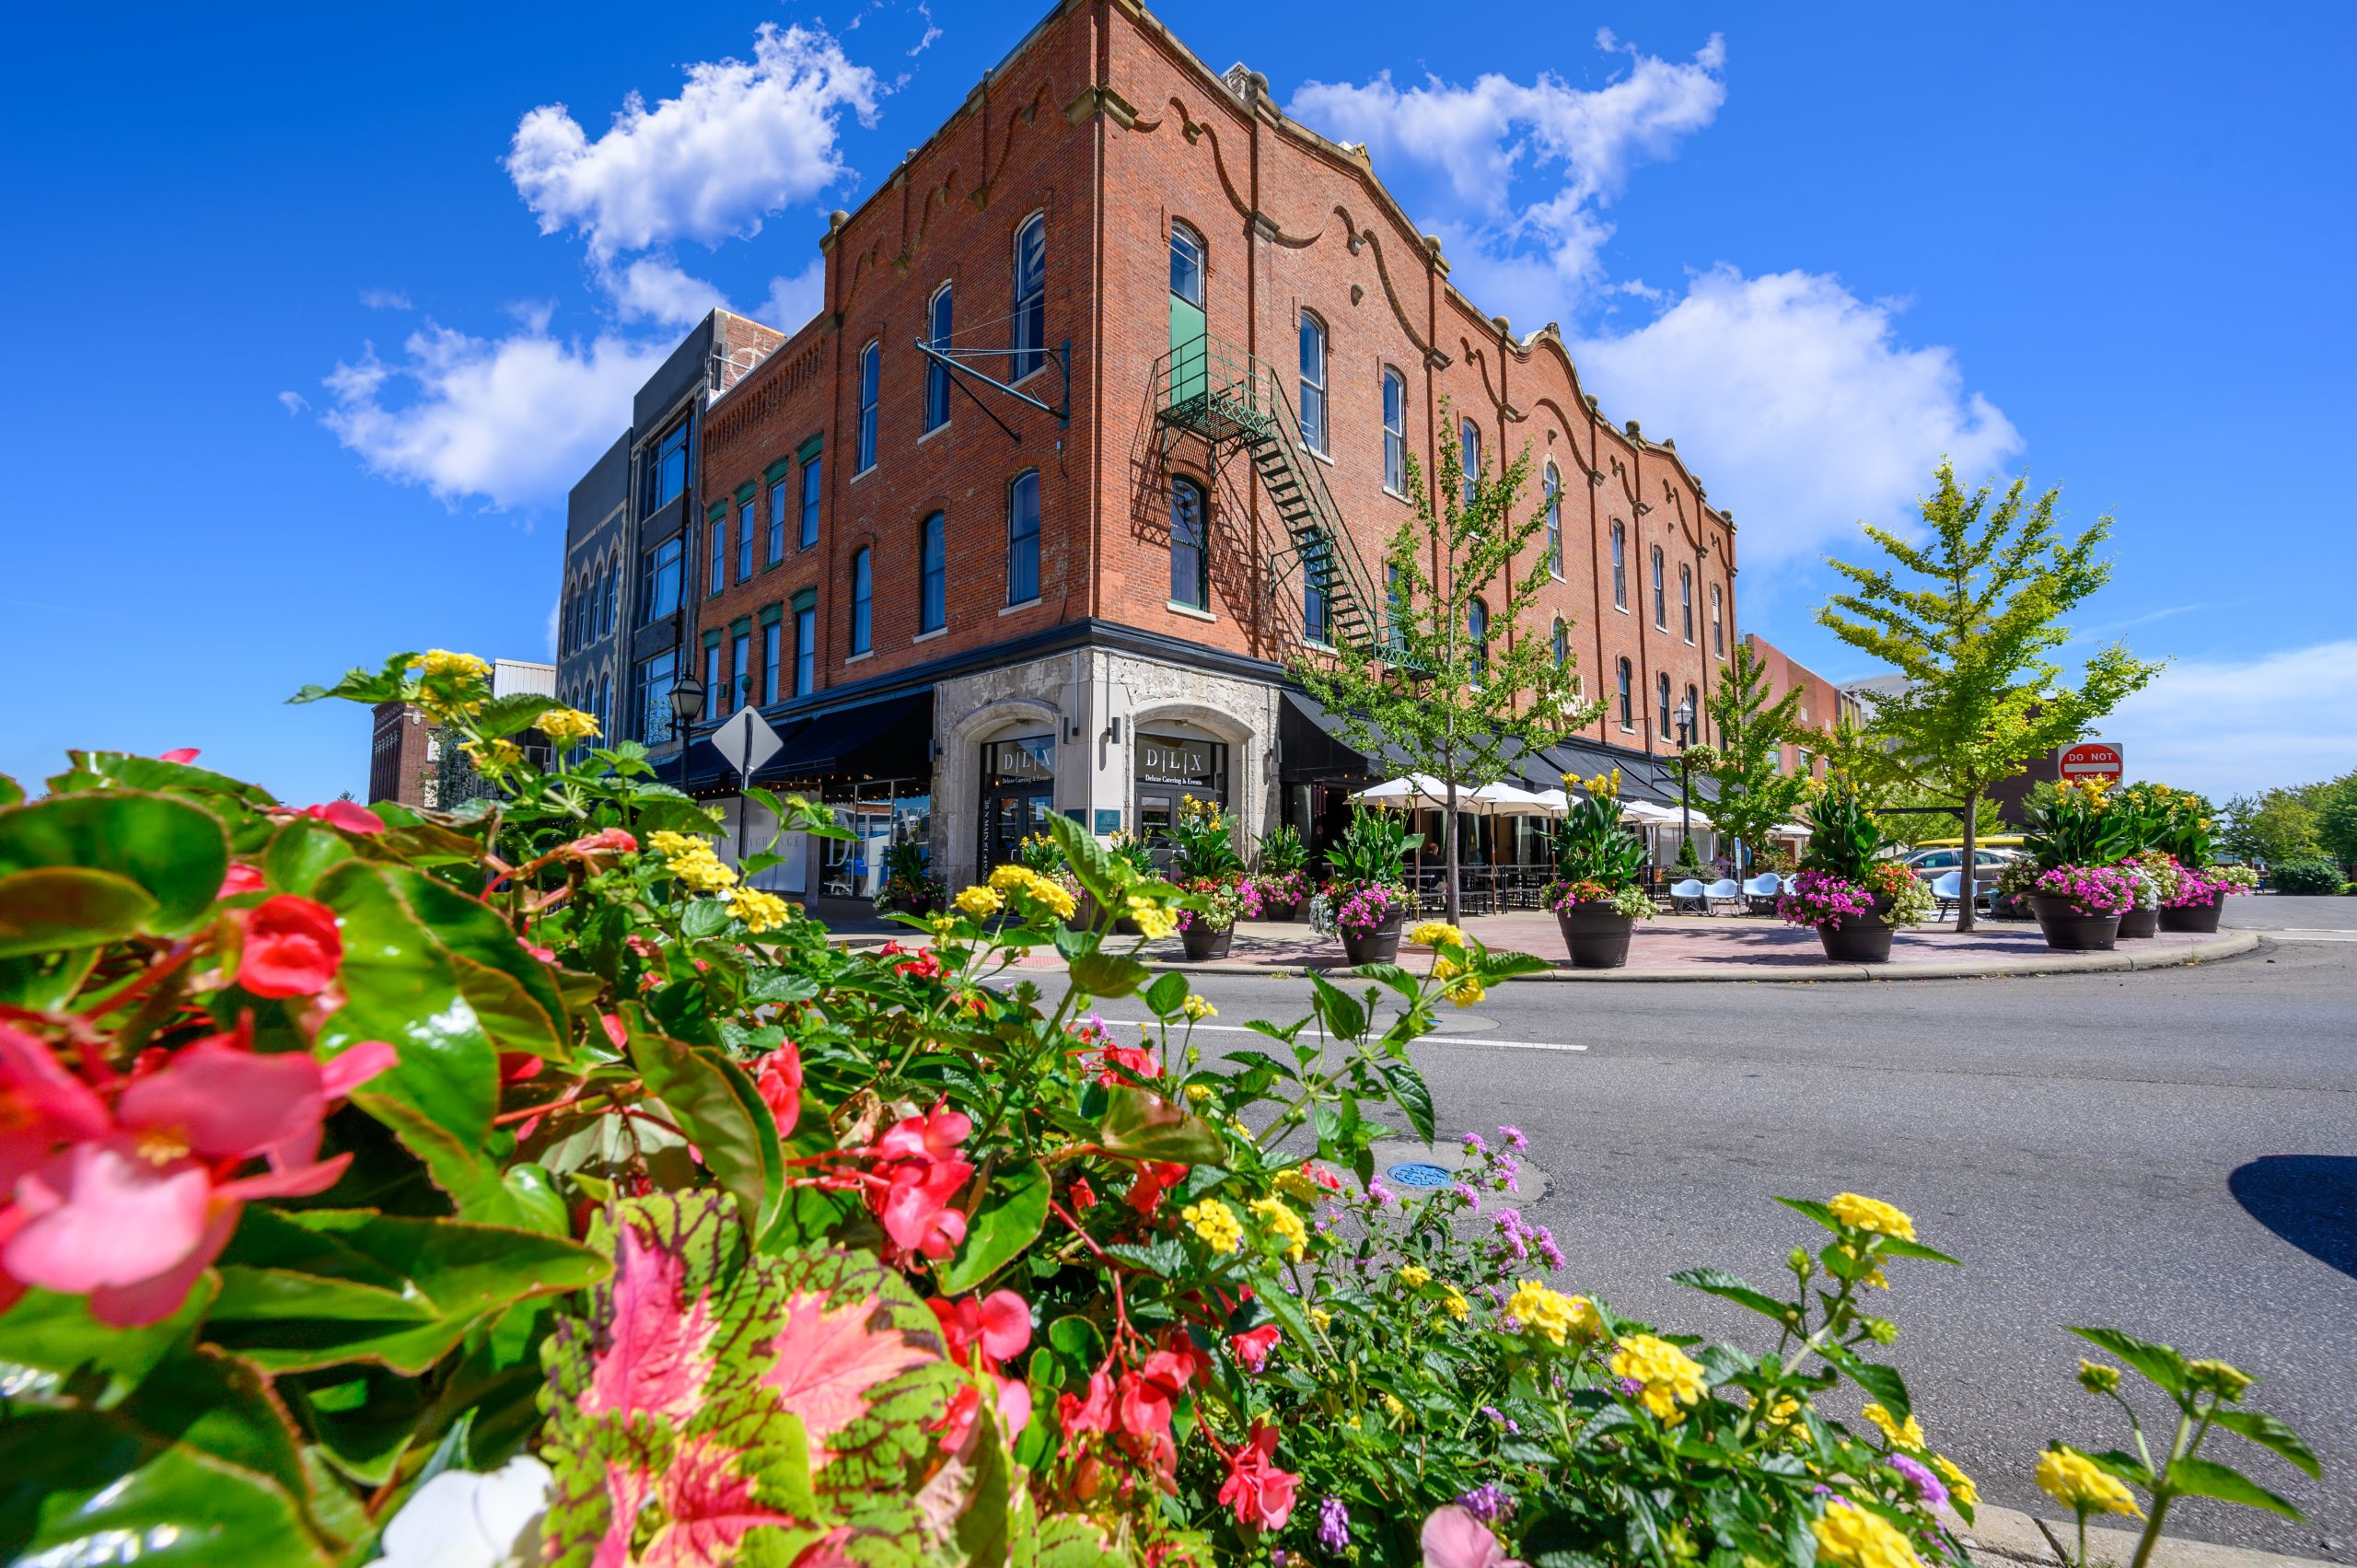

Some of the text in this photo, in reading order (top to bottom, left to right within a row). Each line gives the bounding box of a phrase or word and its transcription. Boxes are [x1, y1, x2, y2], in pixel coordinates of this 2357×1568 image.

[2069, 752, 2113, 761] DO NOT
[1145, 773, 1162, 783] Deluxe
[1162, 775, 1182, 785] Catering
[1187, 777, 1202, 785] Events
[2074, 774, 2110, 783] ENTR
